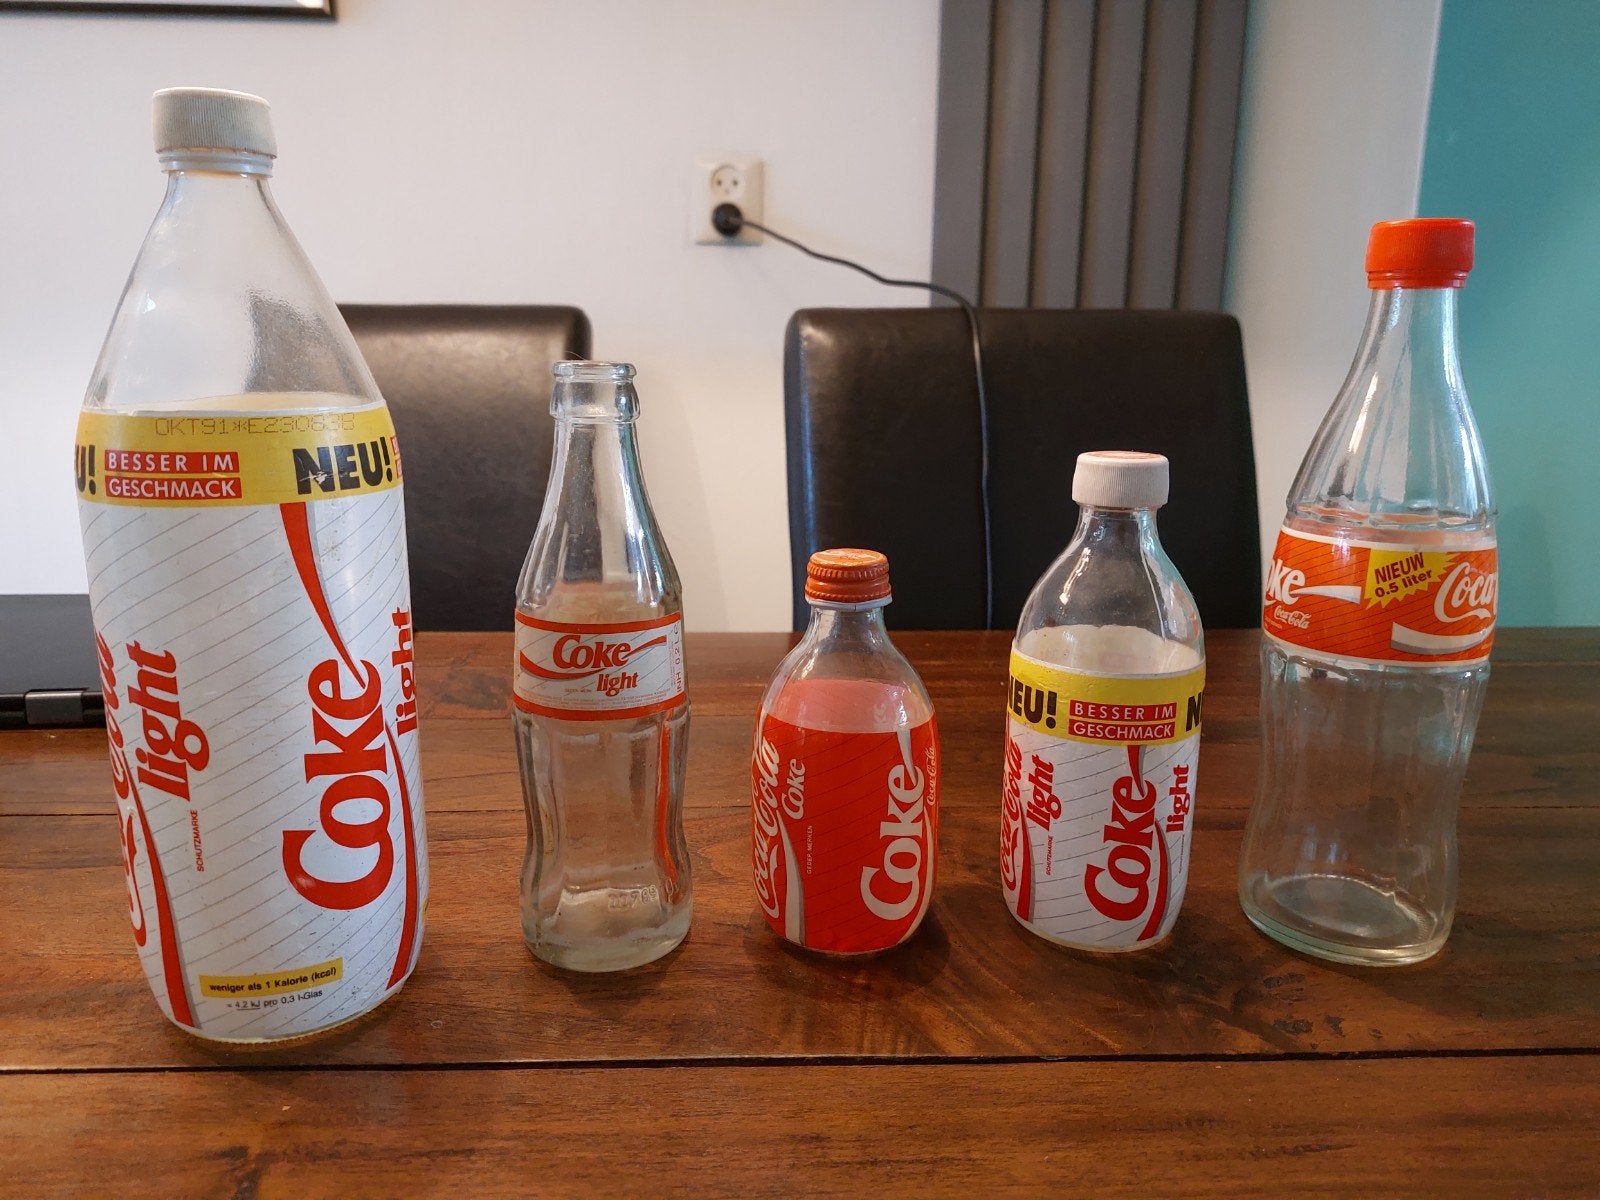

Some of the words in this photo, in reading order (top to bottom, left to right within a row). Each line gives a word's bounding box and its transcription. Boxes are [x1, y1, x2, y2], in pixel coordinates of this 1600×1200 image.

[108, 453, 189, 472] BESSER
[202, 453, 235, 472] IM
[292, 436, 393, 494] NEU!
[108, 477, 238, 498] GESCHMACK
[1374, 552, 1425, 585] NIEUW
[1374, 582, 1399, 598] 0.5
[1402, 569, 1432, 588] liter
[552, 634, 632, 669] Coke
[596, 671, 639, 697] light
[126, 640, 210, 802] light
[1073, 722, 1172, 739] GESCHMACK
[1074, 702, 1145, 721] BESSER
[1154, 704, 1174, 719] IM
[281, 658, 394, 910] Coke
[782, 758, 806, 820] Coke
[1026, 754, 1062, 831] light
[1166, 763, 1191, 833] light
[190, 809, 205, 873] SCHUTZMARKE
[860, 764, 925, 921] Coke
[1084, 775, 1157, 922] Coke
[209, 984, 245, 993] weniger
[274, 975, 309, 988] Kalorie
[311, 967, 337, 982] (kcal)
